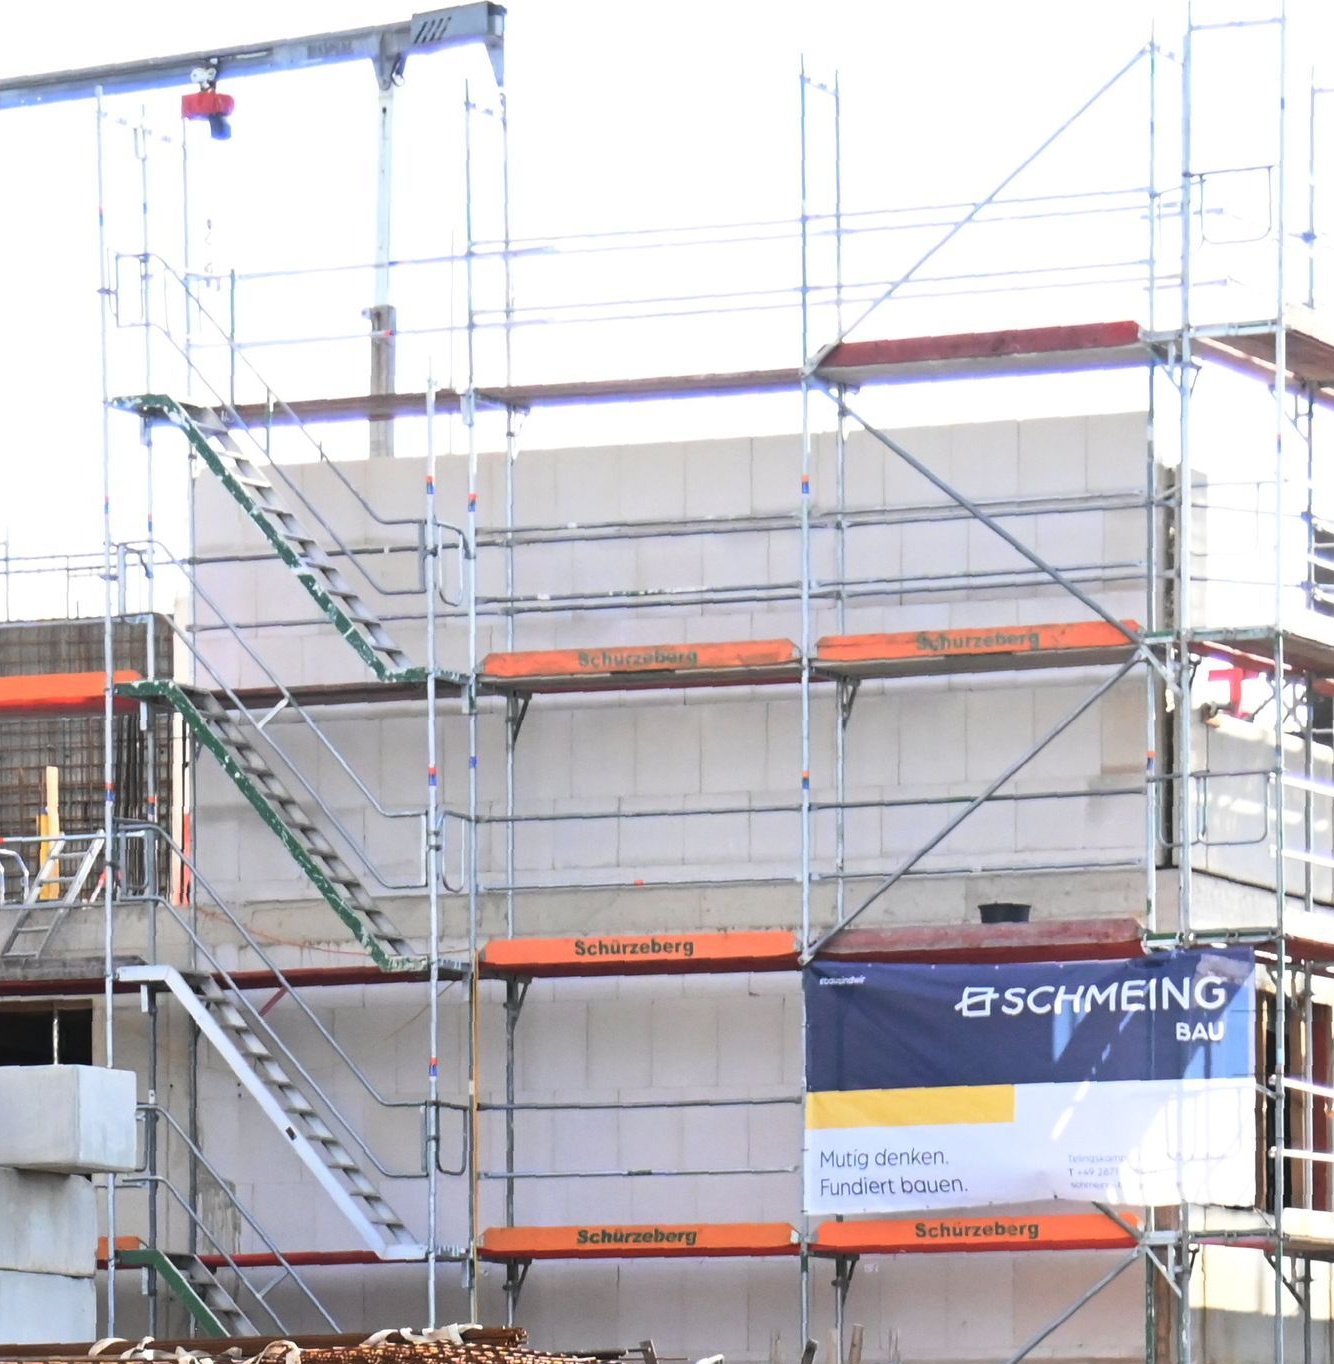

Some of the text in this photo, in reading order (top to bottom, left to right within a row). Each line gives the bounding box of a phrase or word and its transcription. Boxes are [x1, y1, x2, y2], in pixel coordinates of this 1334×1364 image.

[574, 938, 695, 958] Schürzeberg
[1001, 976, 1227, 1016] SCHMEING
[1175, 1020, 1226, 1042] BAU
[819, 1148, 950, 1170] Mutig denken.
[819, 1176, 969, 1197] Fundiert bauen.
[577, 1227, 698, 1247] Schürzeberg
[914, 1221, 1040, 1240] Schürzeberg
